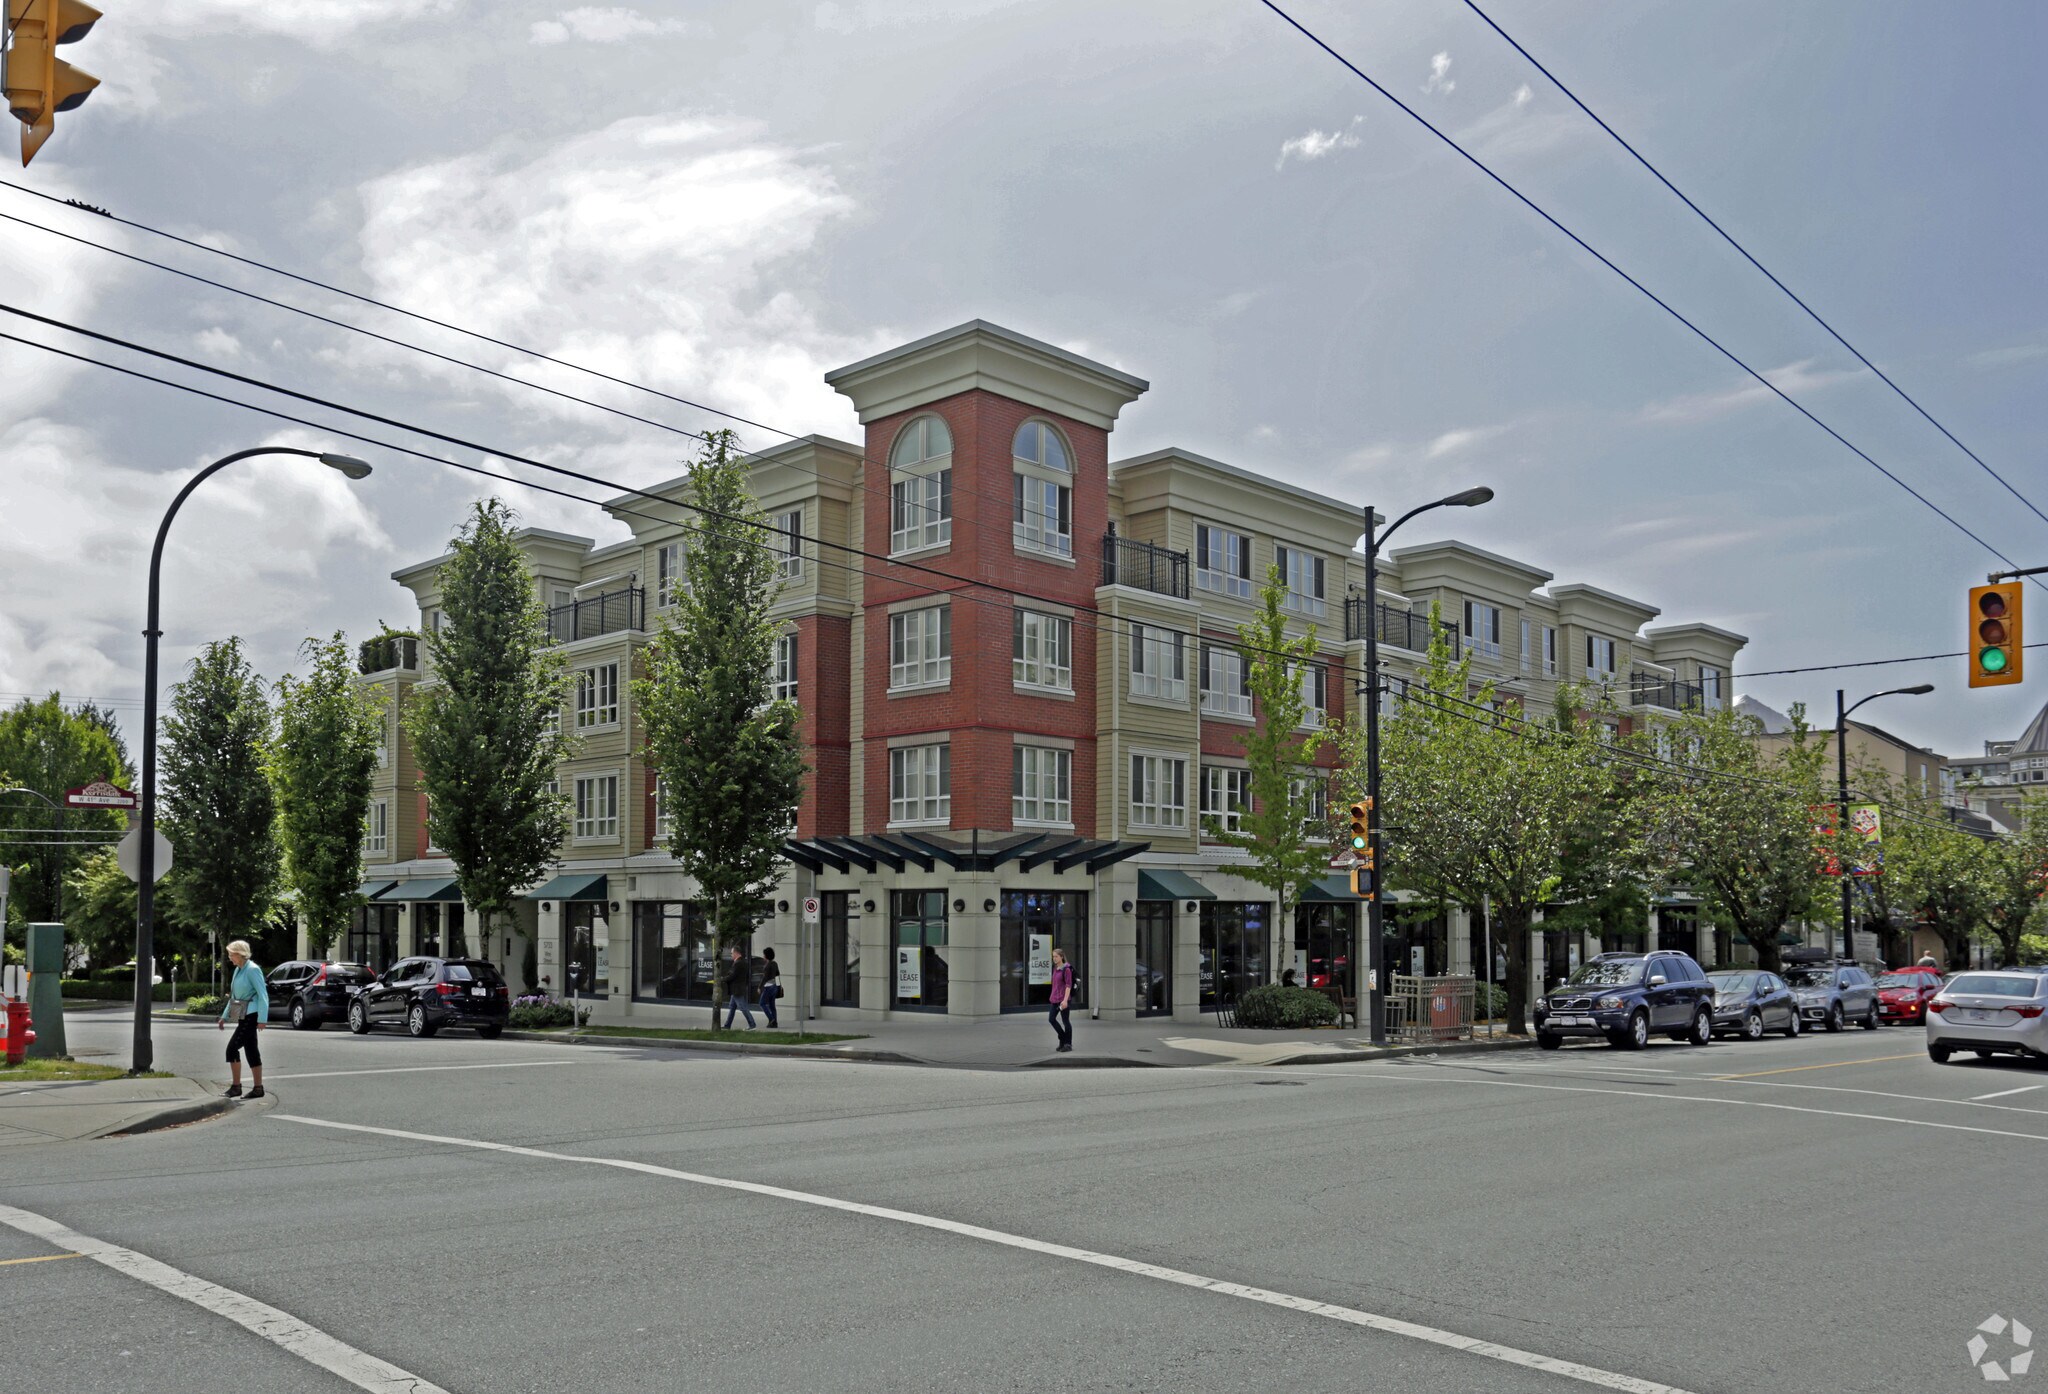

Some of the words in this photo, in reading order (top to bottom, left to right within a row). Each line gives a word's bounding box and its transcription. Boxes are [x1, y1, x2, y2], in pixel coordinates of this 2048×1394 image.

[698, 961, 713, 969] LEASE
[1031, 960, 1050, 968] LEASE
[900, 973, 919, 982] LEASE
[1200, 972, 1213, 980] EASE
